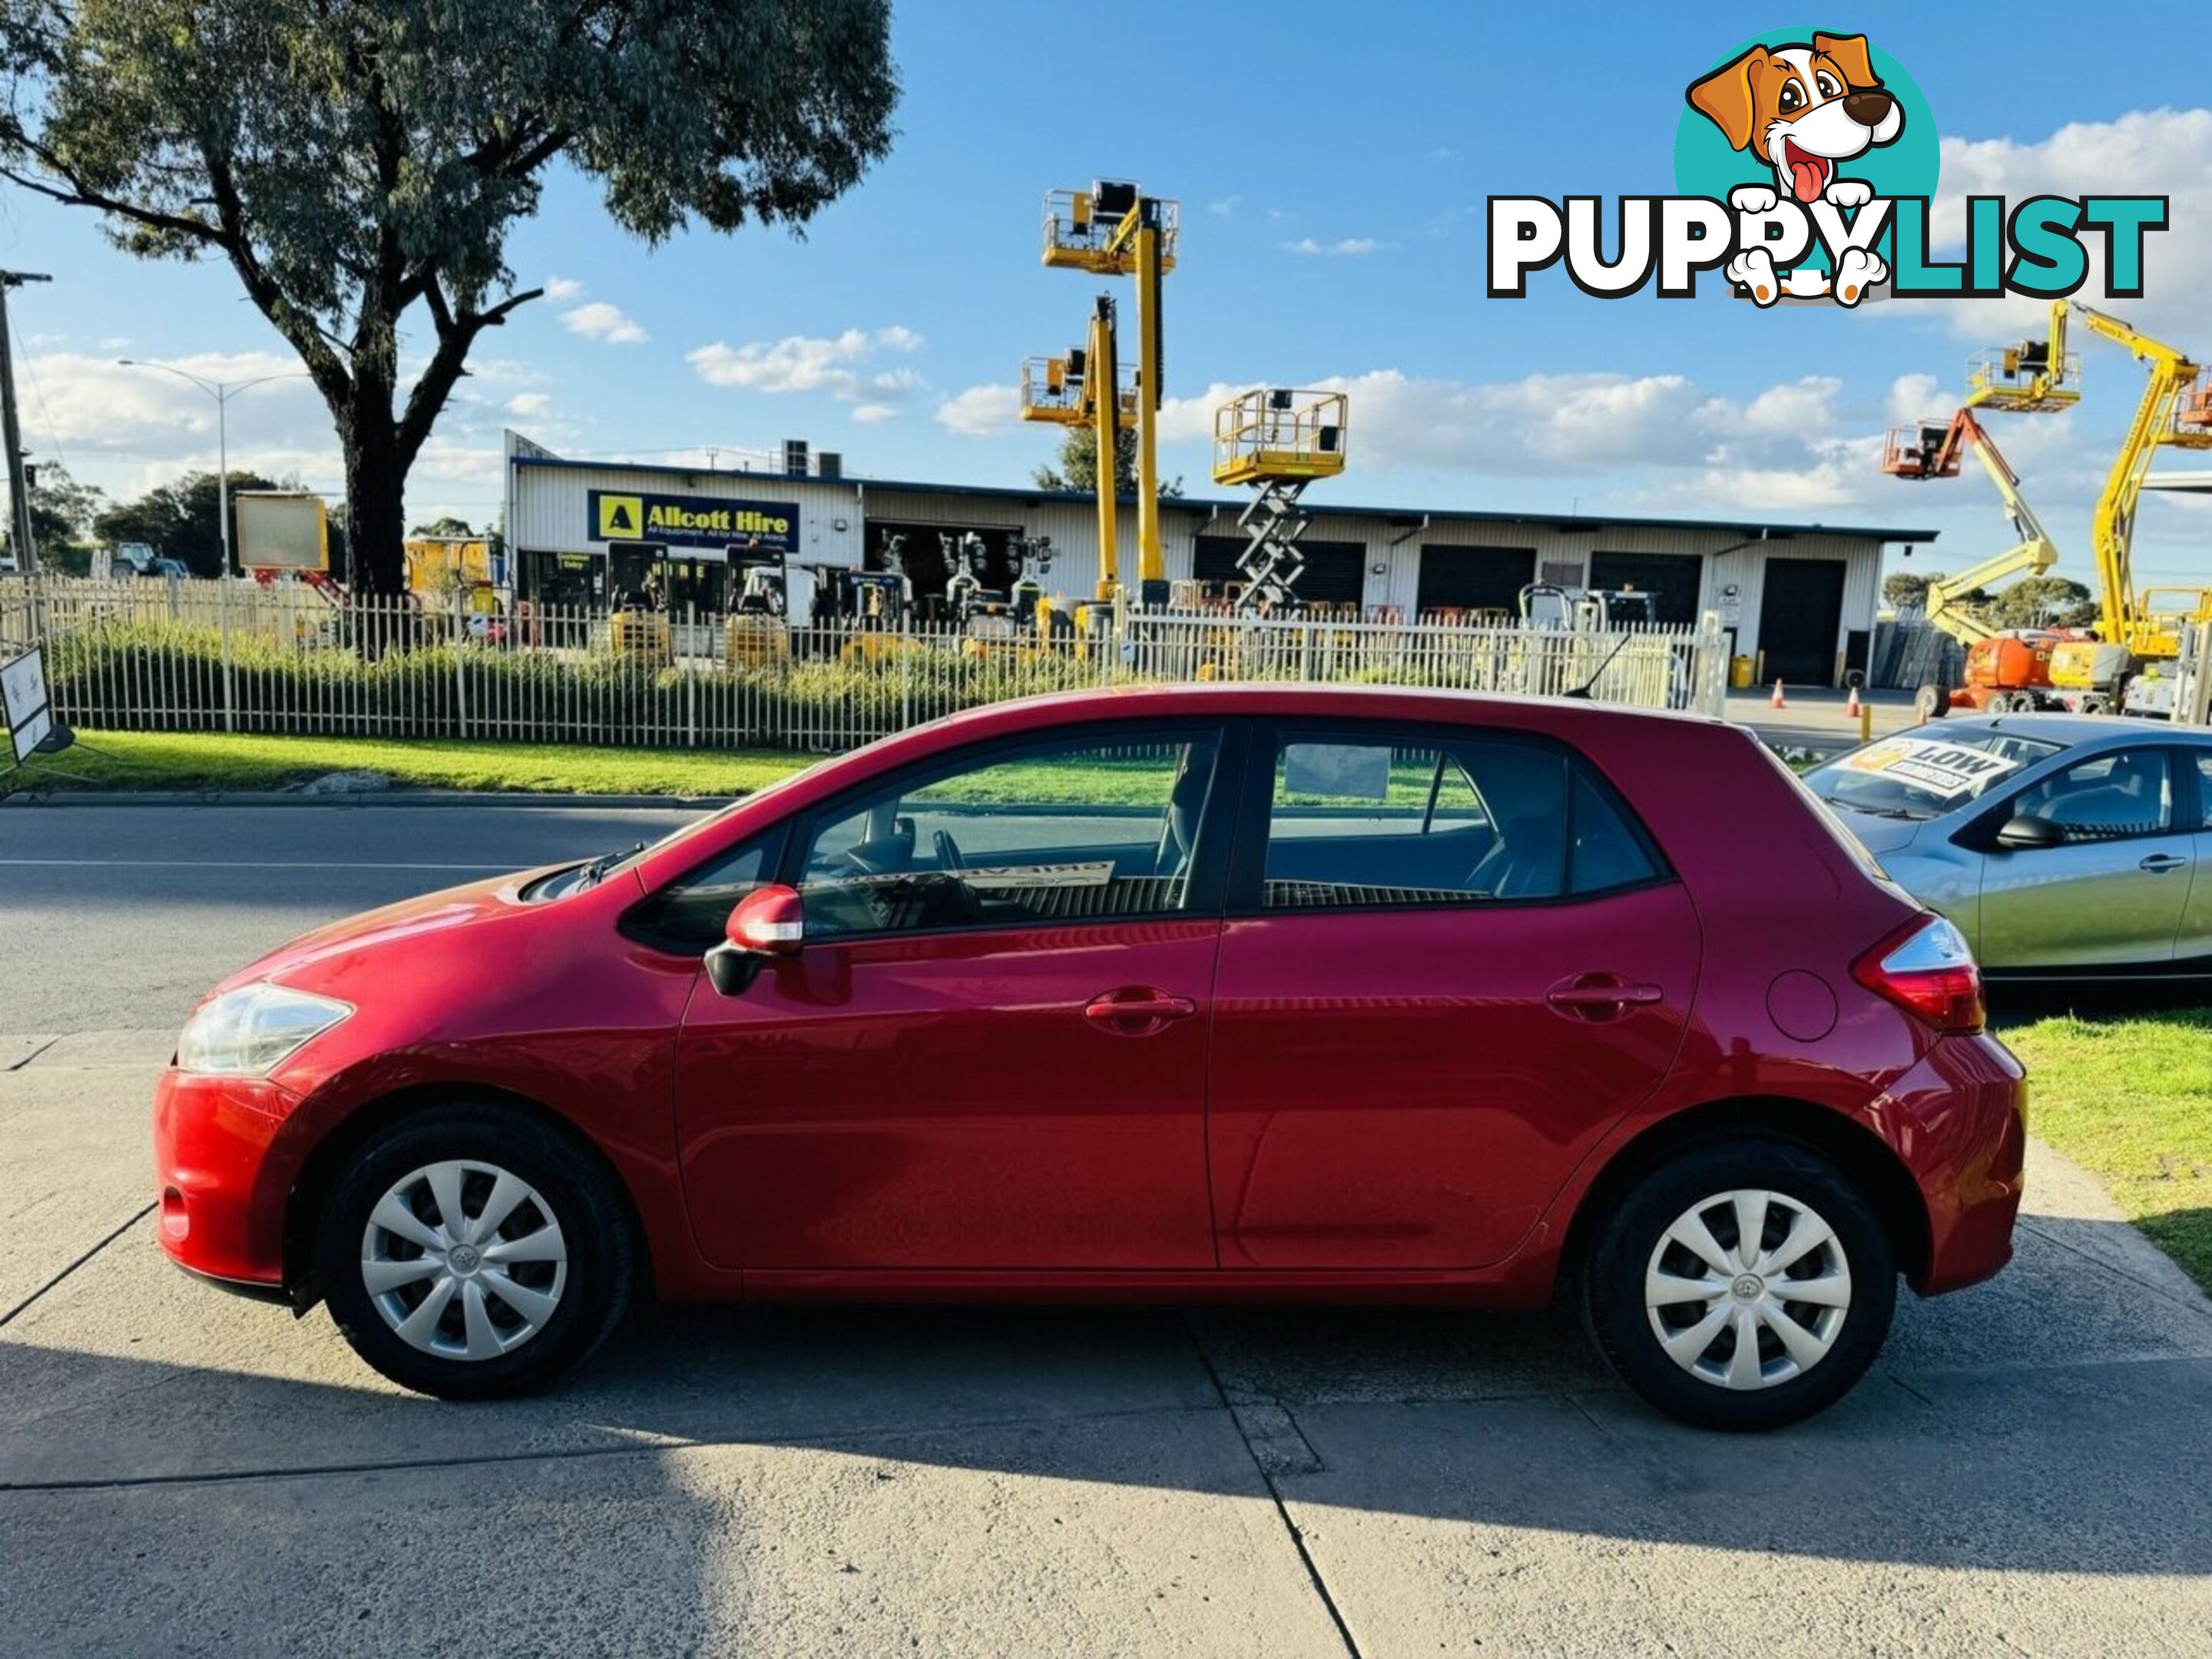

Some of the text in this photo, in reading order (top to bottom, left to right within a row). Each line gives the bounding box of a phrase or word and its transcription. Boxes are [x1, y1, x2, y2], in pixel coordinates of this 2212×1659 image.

[647, 505, 789, 534] Allcott Hire
[1911, 747, 2001, 774] LOW
